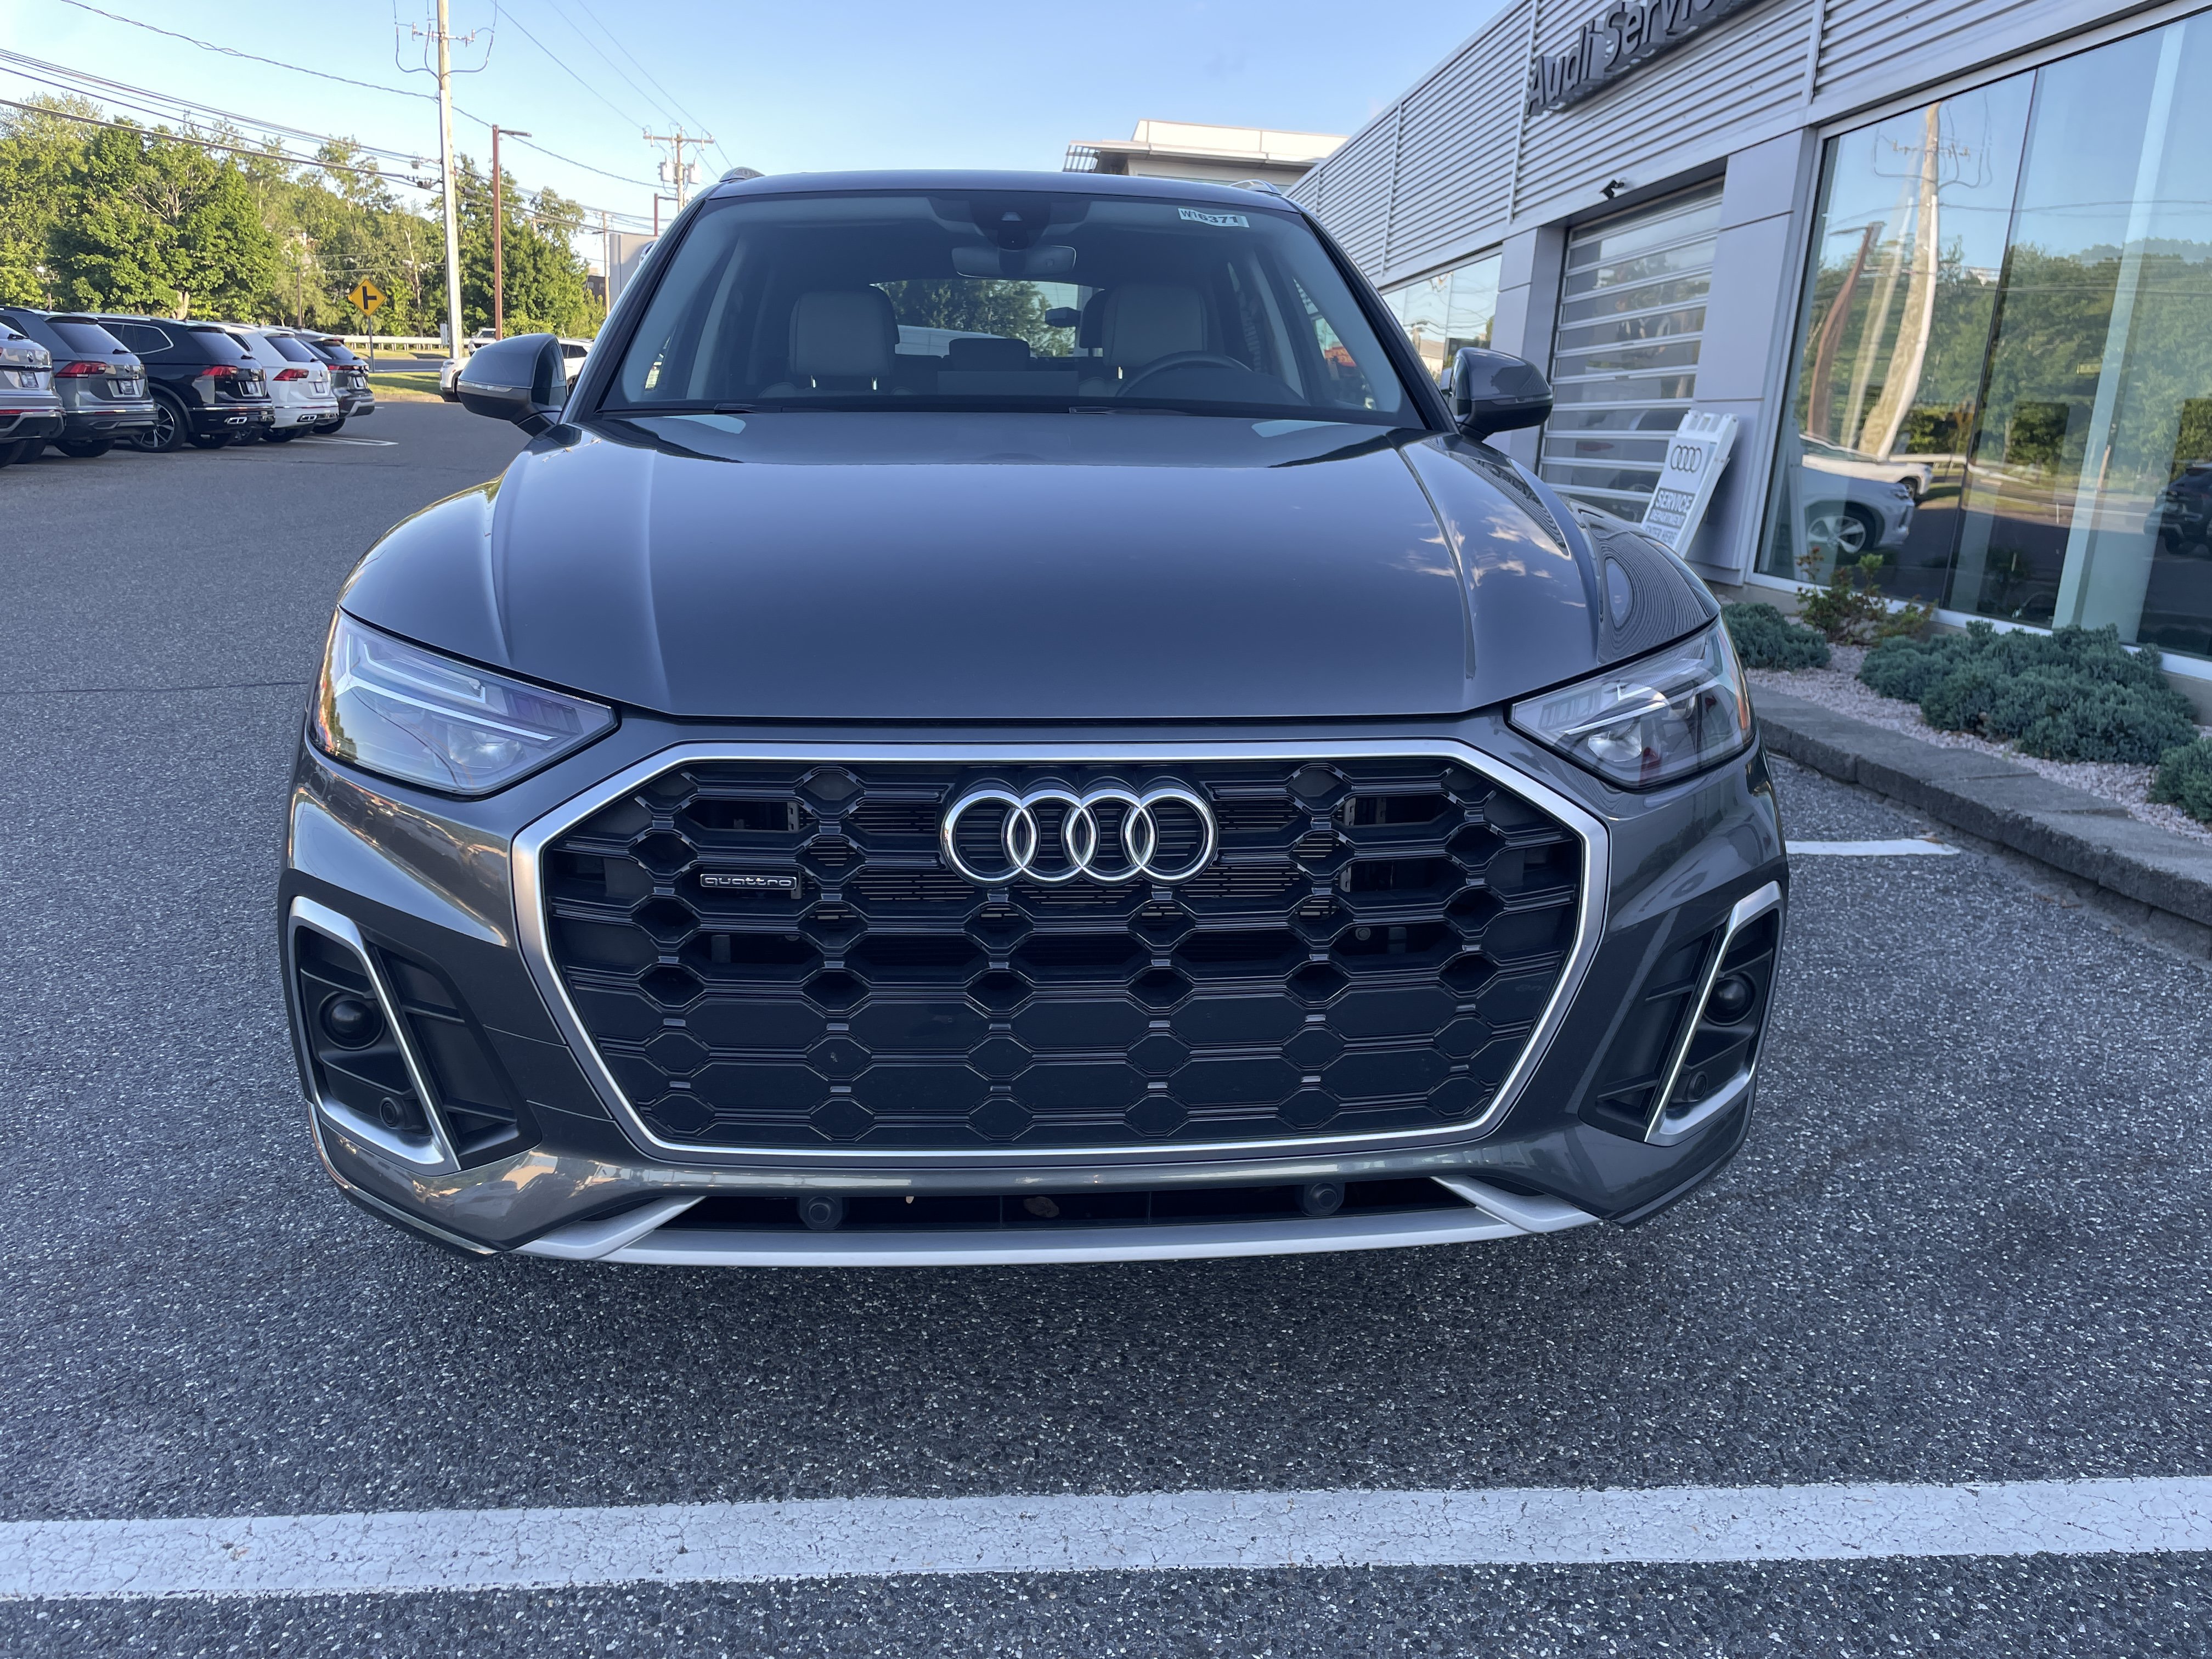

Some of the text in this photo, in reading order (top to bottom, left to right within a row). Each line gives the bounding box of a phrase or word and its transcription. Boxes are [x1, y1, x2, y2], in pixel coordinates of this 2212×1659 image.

[1525, 18, 1595, 115] Audi
[1655, 490, 1693, 513] SERVICE
[704, 877, 792, 887] quattro
